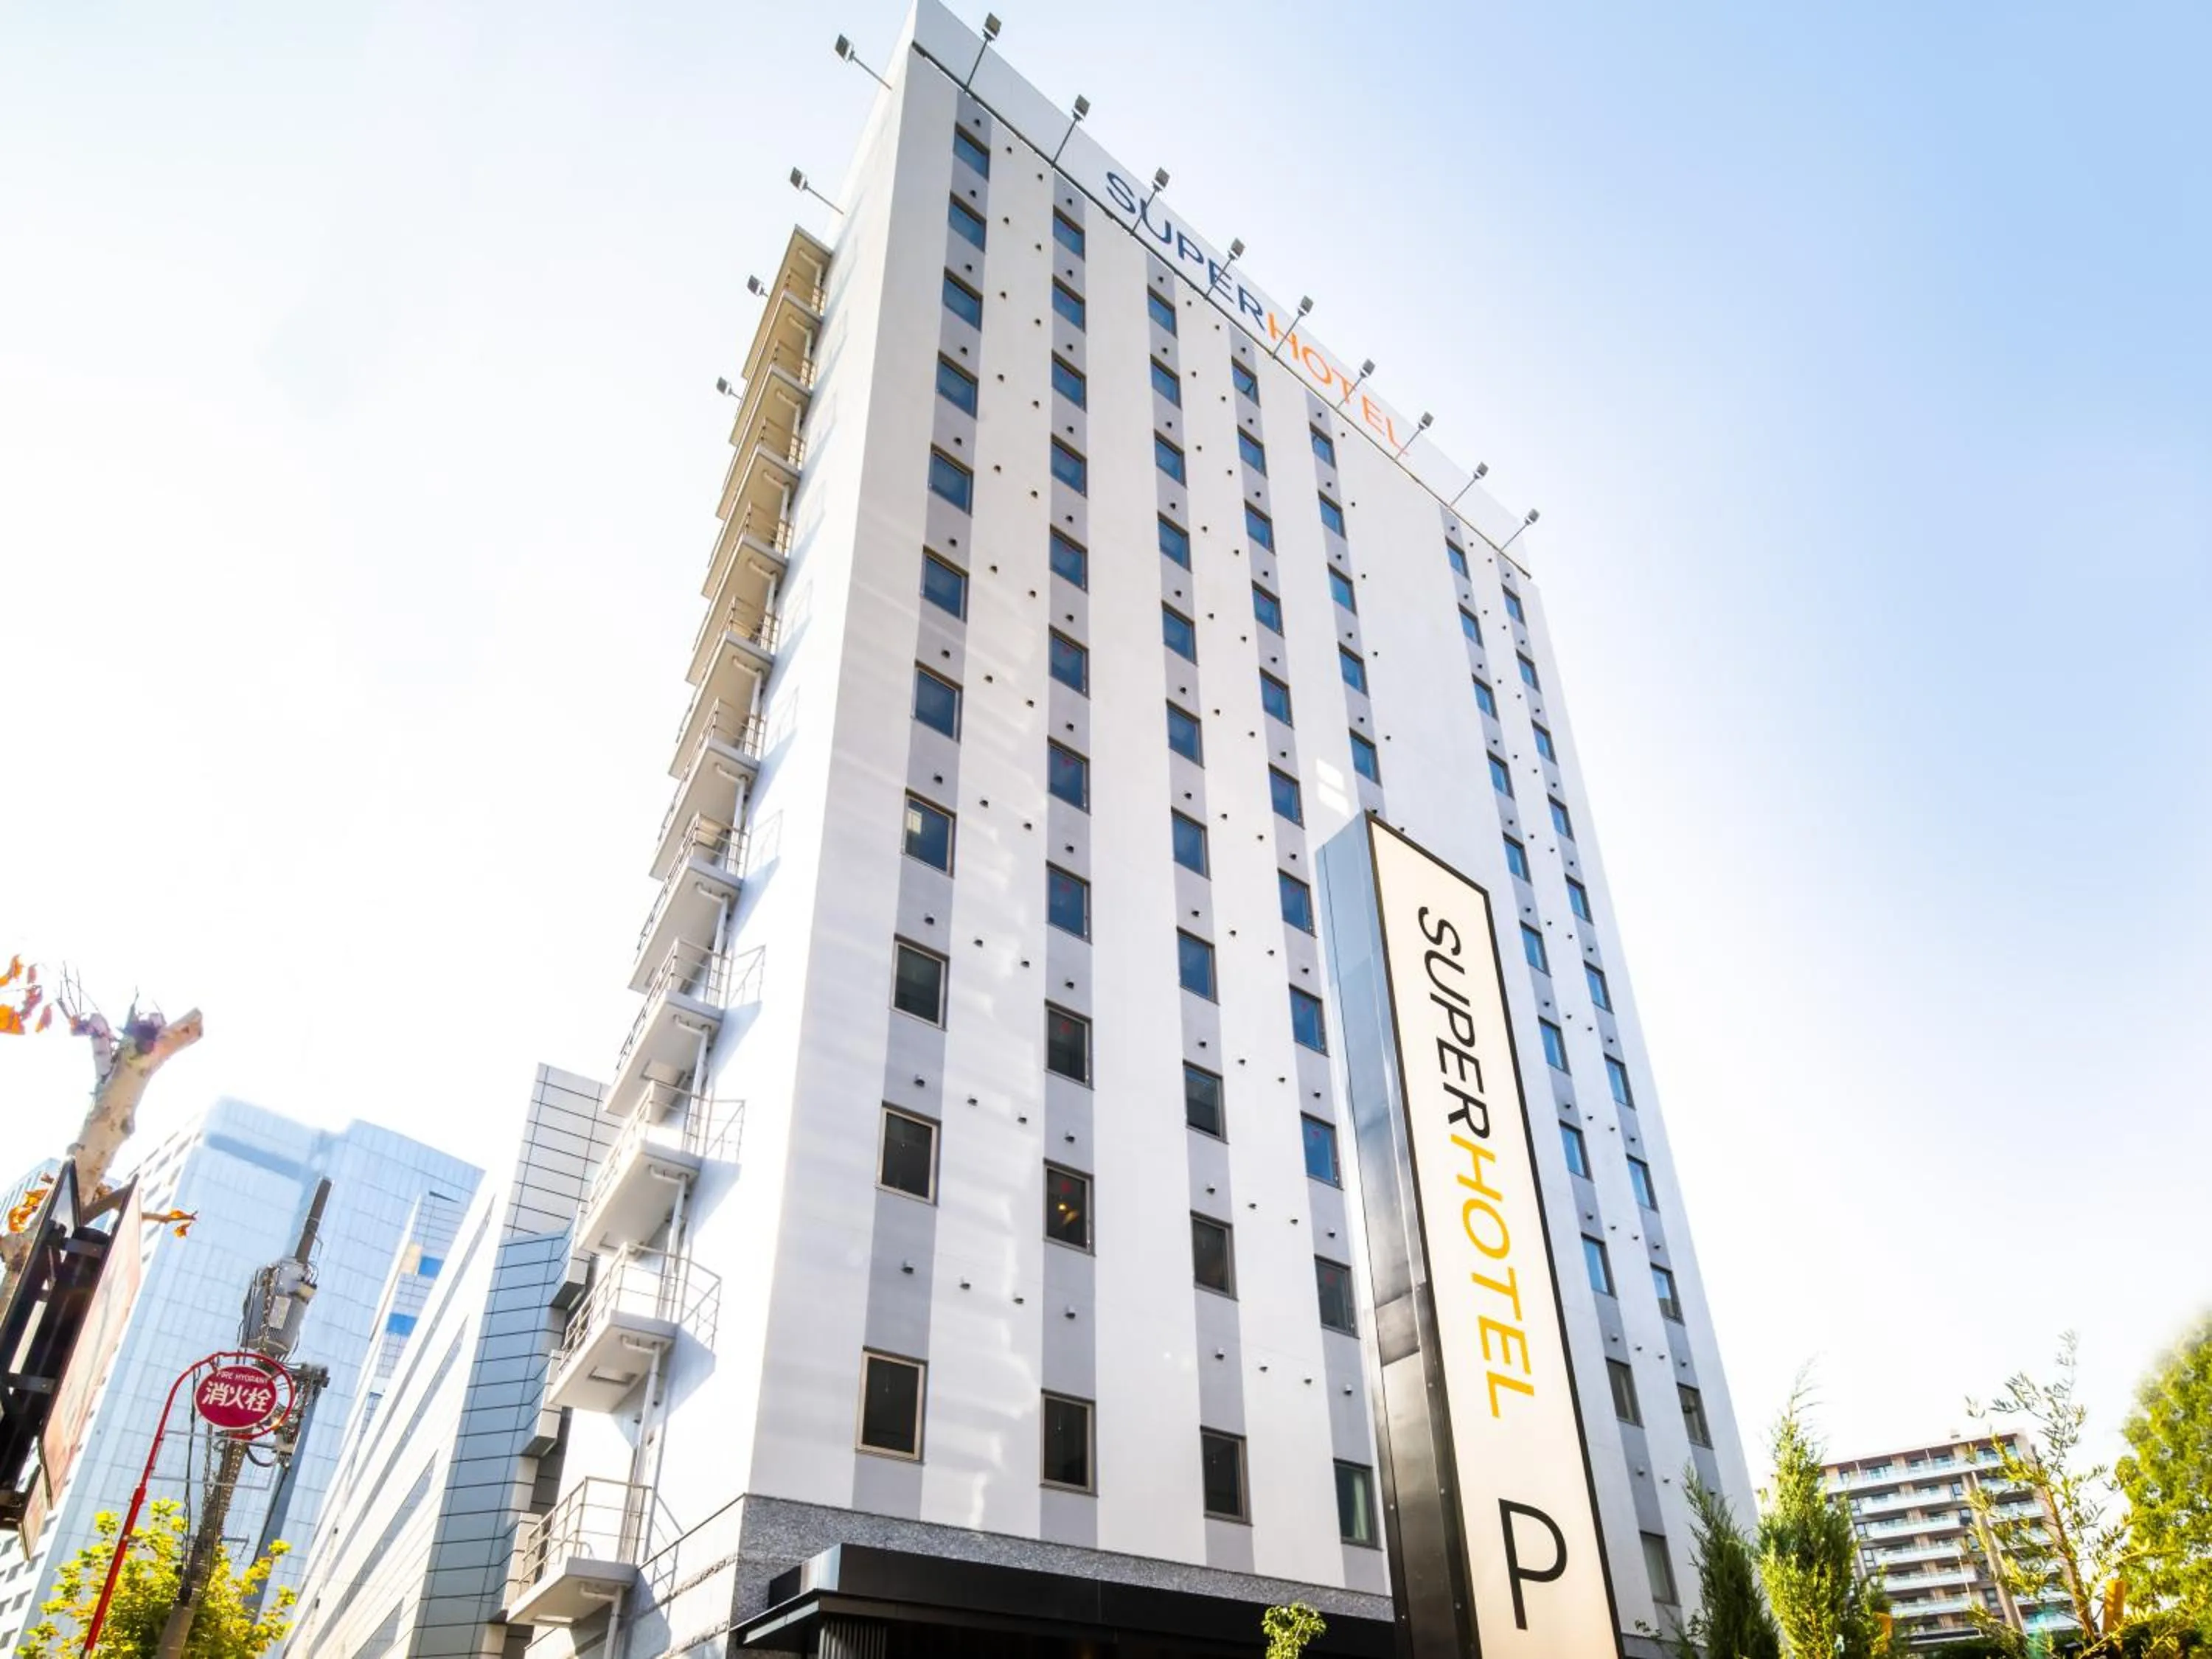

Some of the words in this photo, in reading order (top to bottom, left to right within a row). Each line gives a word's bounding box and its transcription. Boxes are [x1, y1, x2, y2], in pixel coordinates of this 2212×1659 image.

[217, 1371, 234, 1380] FIRE
[201, 1381, 272, 1413] 消火栓
[1498, 1498, 1568, 1630] P
